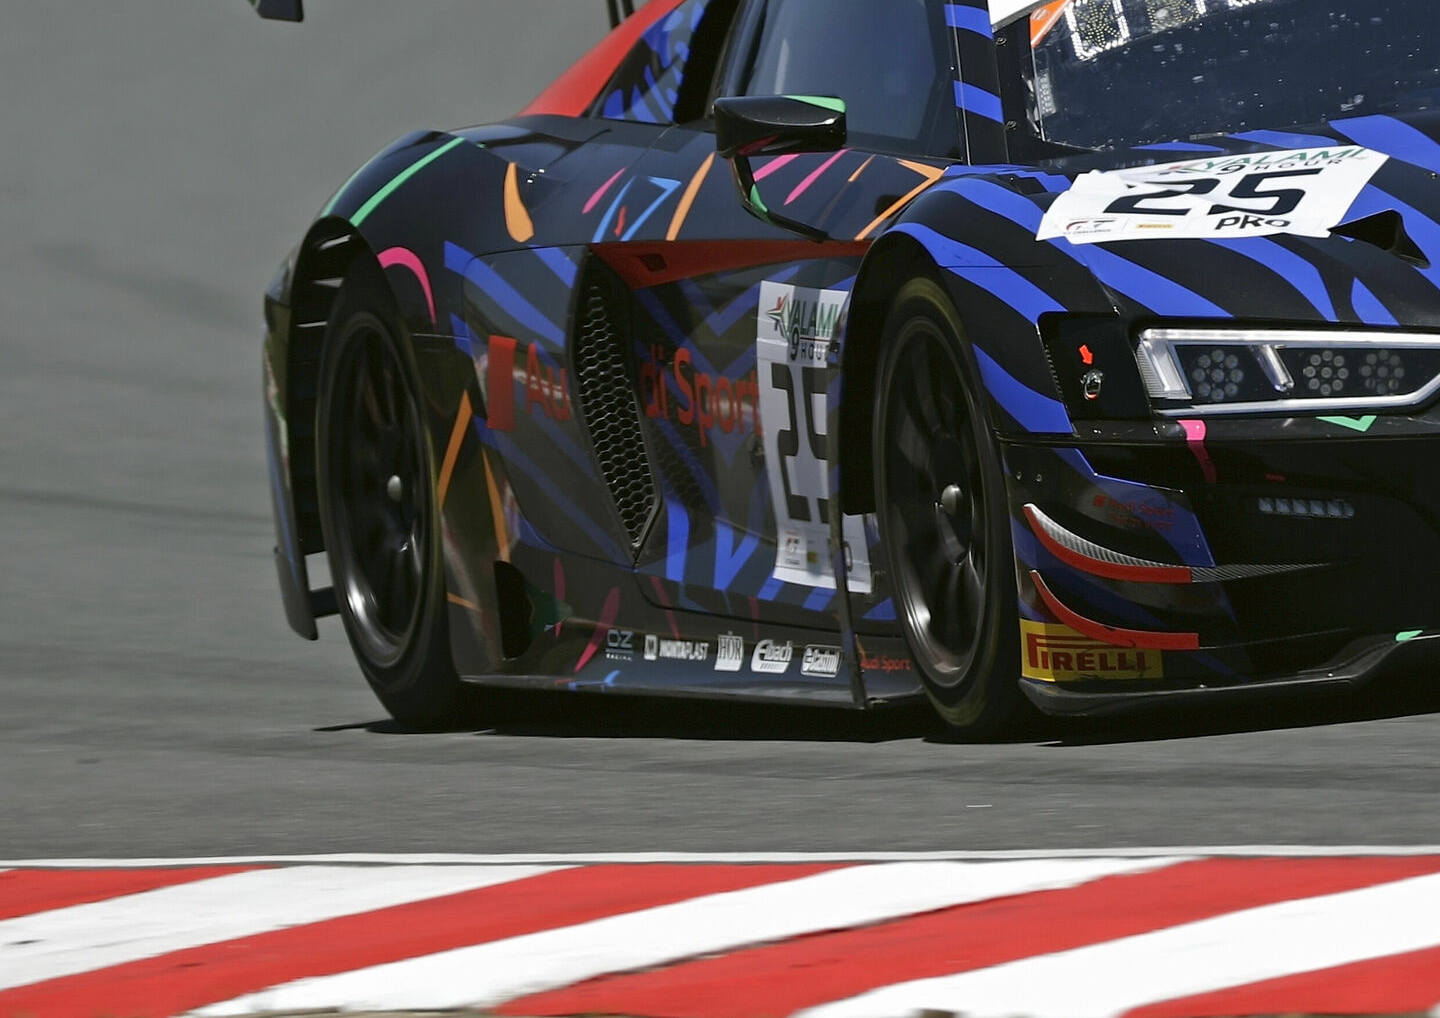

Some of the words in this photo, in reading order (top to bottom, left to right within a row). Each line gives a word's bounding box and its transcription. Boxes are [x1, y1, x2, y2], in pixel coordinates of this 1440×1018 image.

[1216, 164, 1246, 177] 9
[1264, 158, 1343, 172] HOUR
[1102, 168, 1324, 216] 25
[790, 327, 801, 361] 9
[801, 342, 828, 361] HOU
[526, 343, 669, 421] Audi
[1026, 633, 1149, 671] PIRELLI
